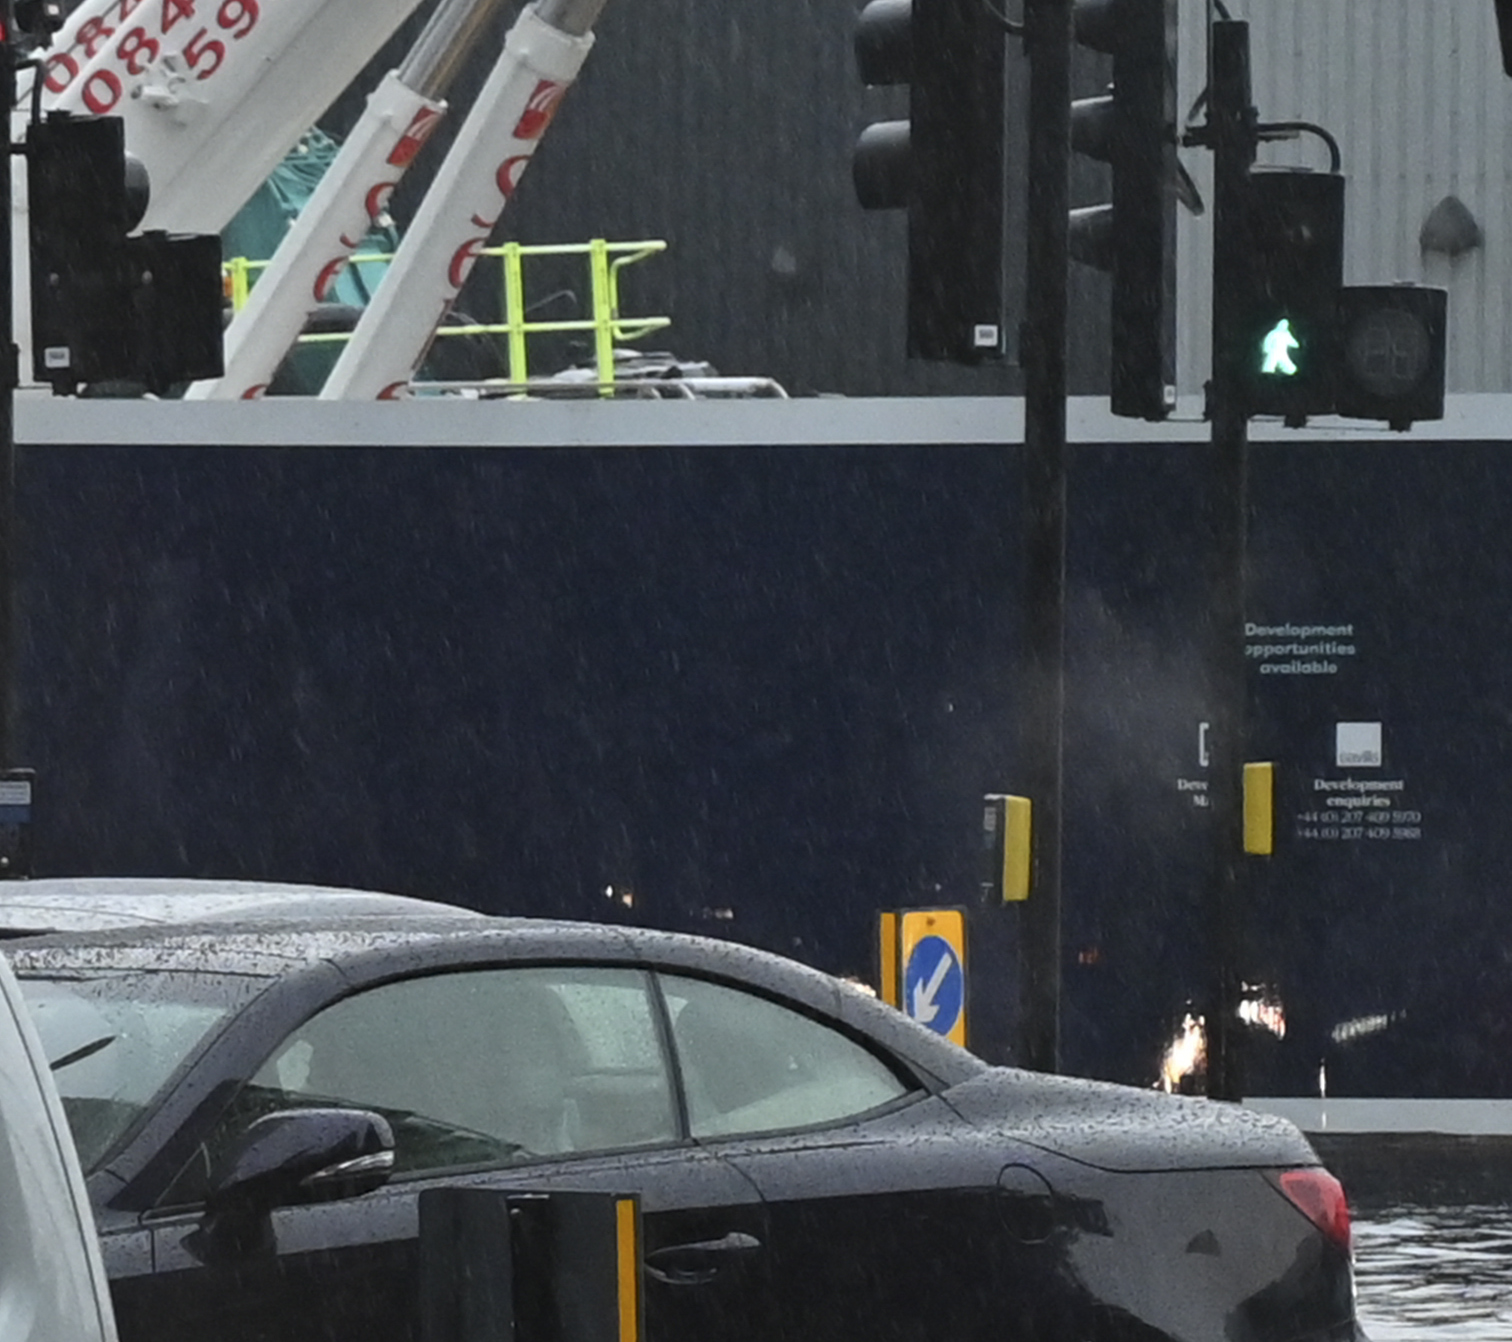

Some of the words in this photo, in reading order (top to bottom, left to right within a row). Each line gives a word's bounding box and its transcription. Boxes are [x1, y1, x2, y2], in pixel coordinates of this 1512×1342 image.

[1245, 622, 1353, 639] Development
[1259, 659, 1338, 674] available
[1314, 777, 1404, 793] Development
[1326, 794, 1391, 809] enquiries
